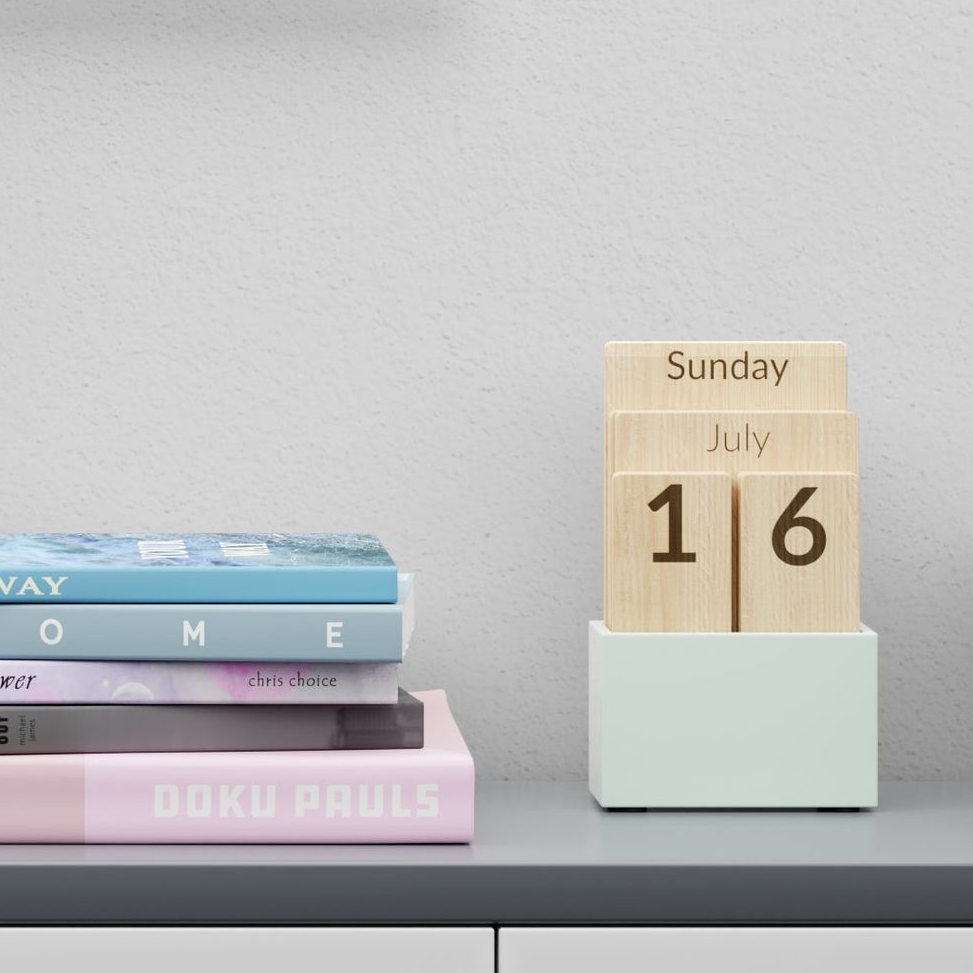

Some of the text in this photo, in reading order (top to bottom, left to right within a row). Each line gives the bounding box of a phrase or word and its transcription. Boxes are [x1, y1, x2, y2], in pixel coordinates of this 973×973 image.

[667, 350, 789, 387] Sunday
[706, 423, 770, 458] July
[248, 670, 337, 688] chris choice
[154, 783, 439, 819] DOKU PAULS
